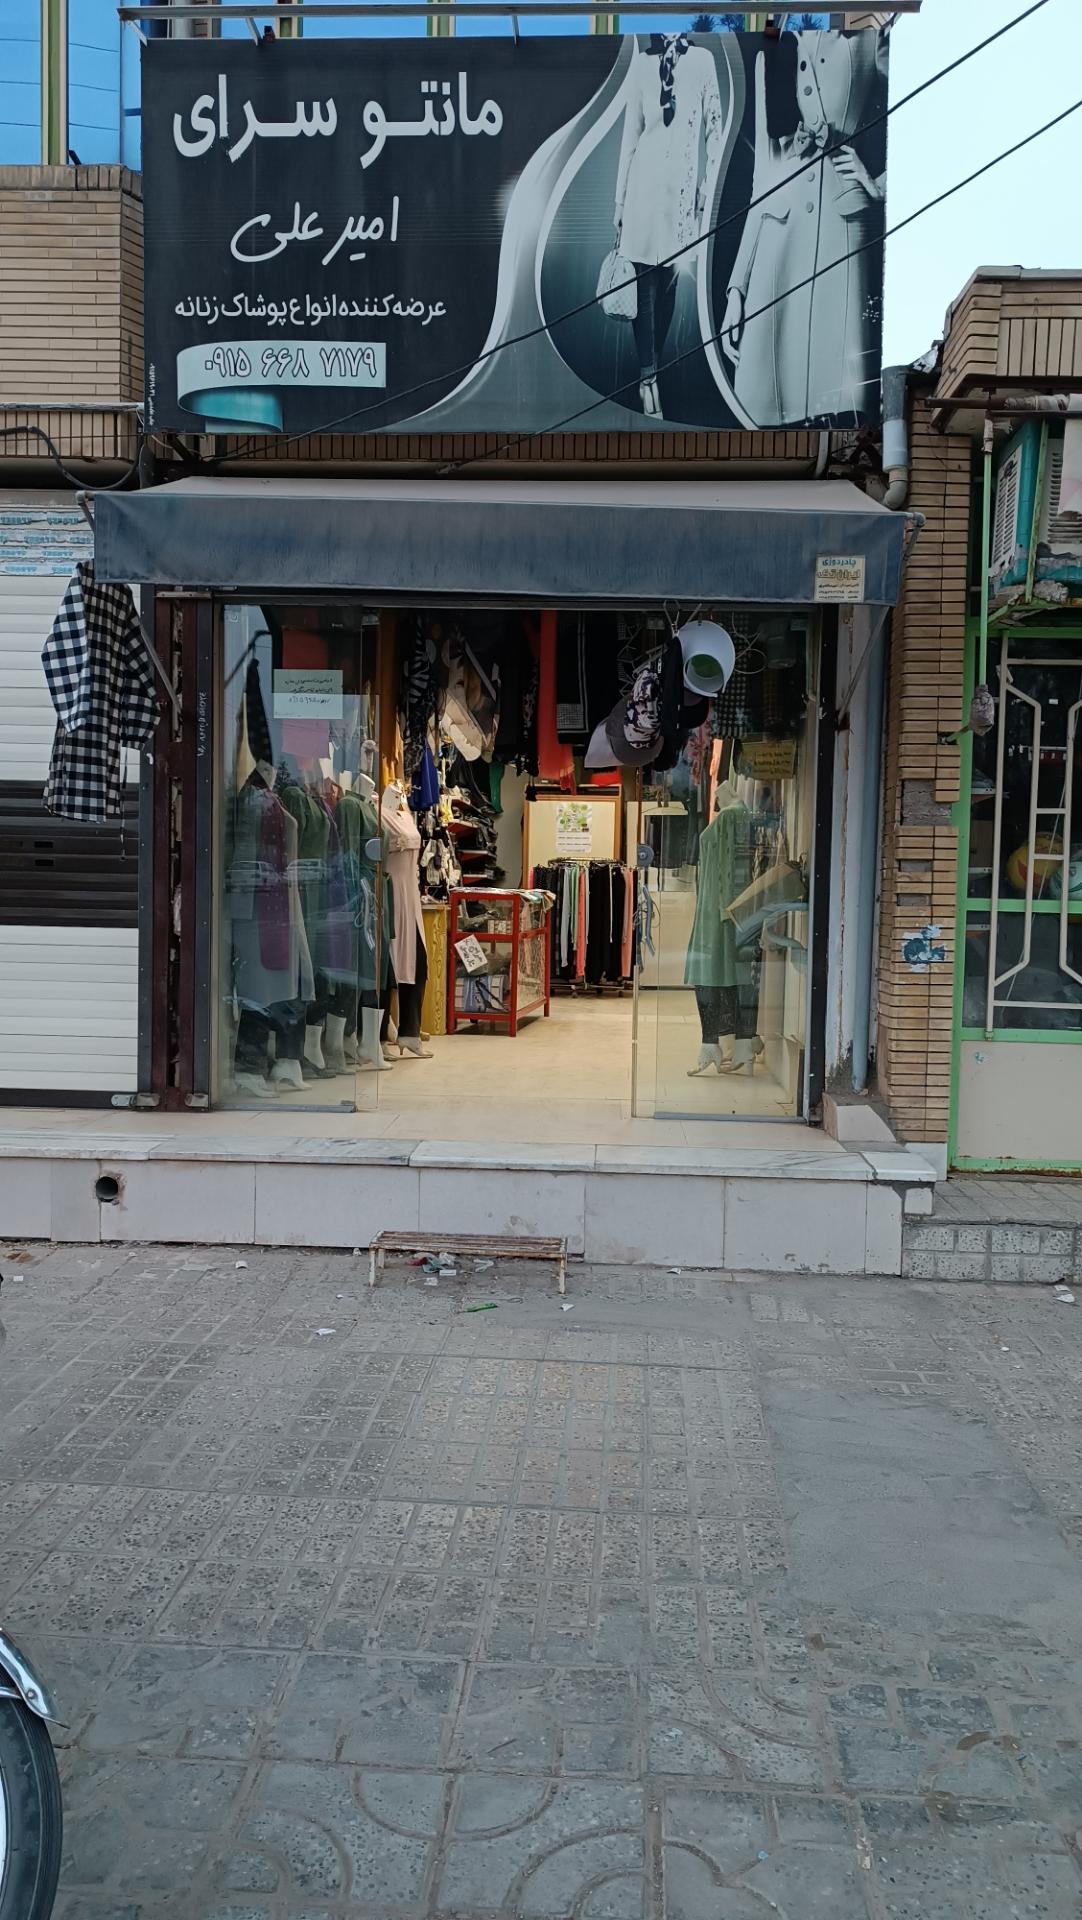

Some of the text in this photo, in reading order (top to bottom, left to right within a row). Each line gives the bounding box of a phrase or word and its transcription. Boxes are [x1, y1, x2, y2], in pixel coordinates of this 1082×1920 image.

[173, 71, 504, 170] مانتو سرای
[230, 195, 400, 266] امیر علی
[174, 292, 447, 327] عرضه کننده انواع پوشاک زنانه
[260, 347, 310, 378] ۶۶۸
[318, 347, 378, 378] ۷۱۷۹
